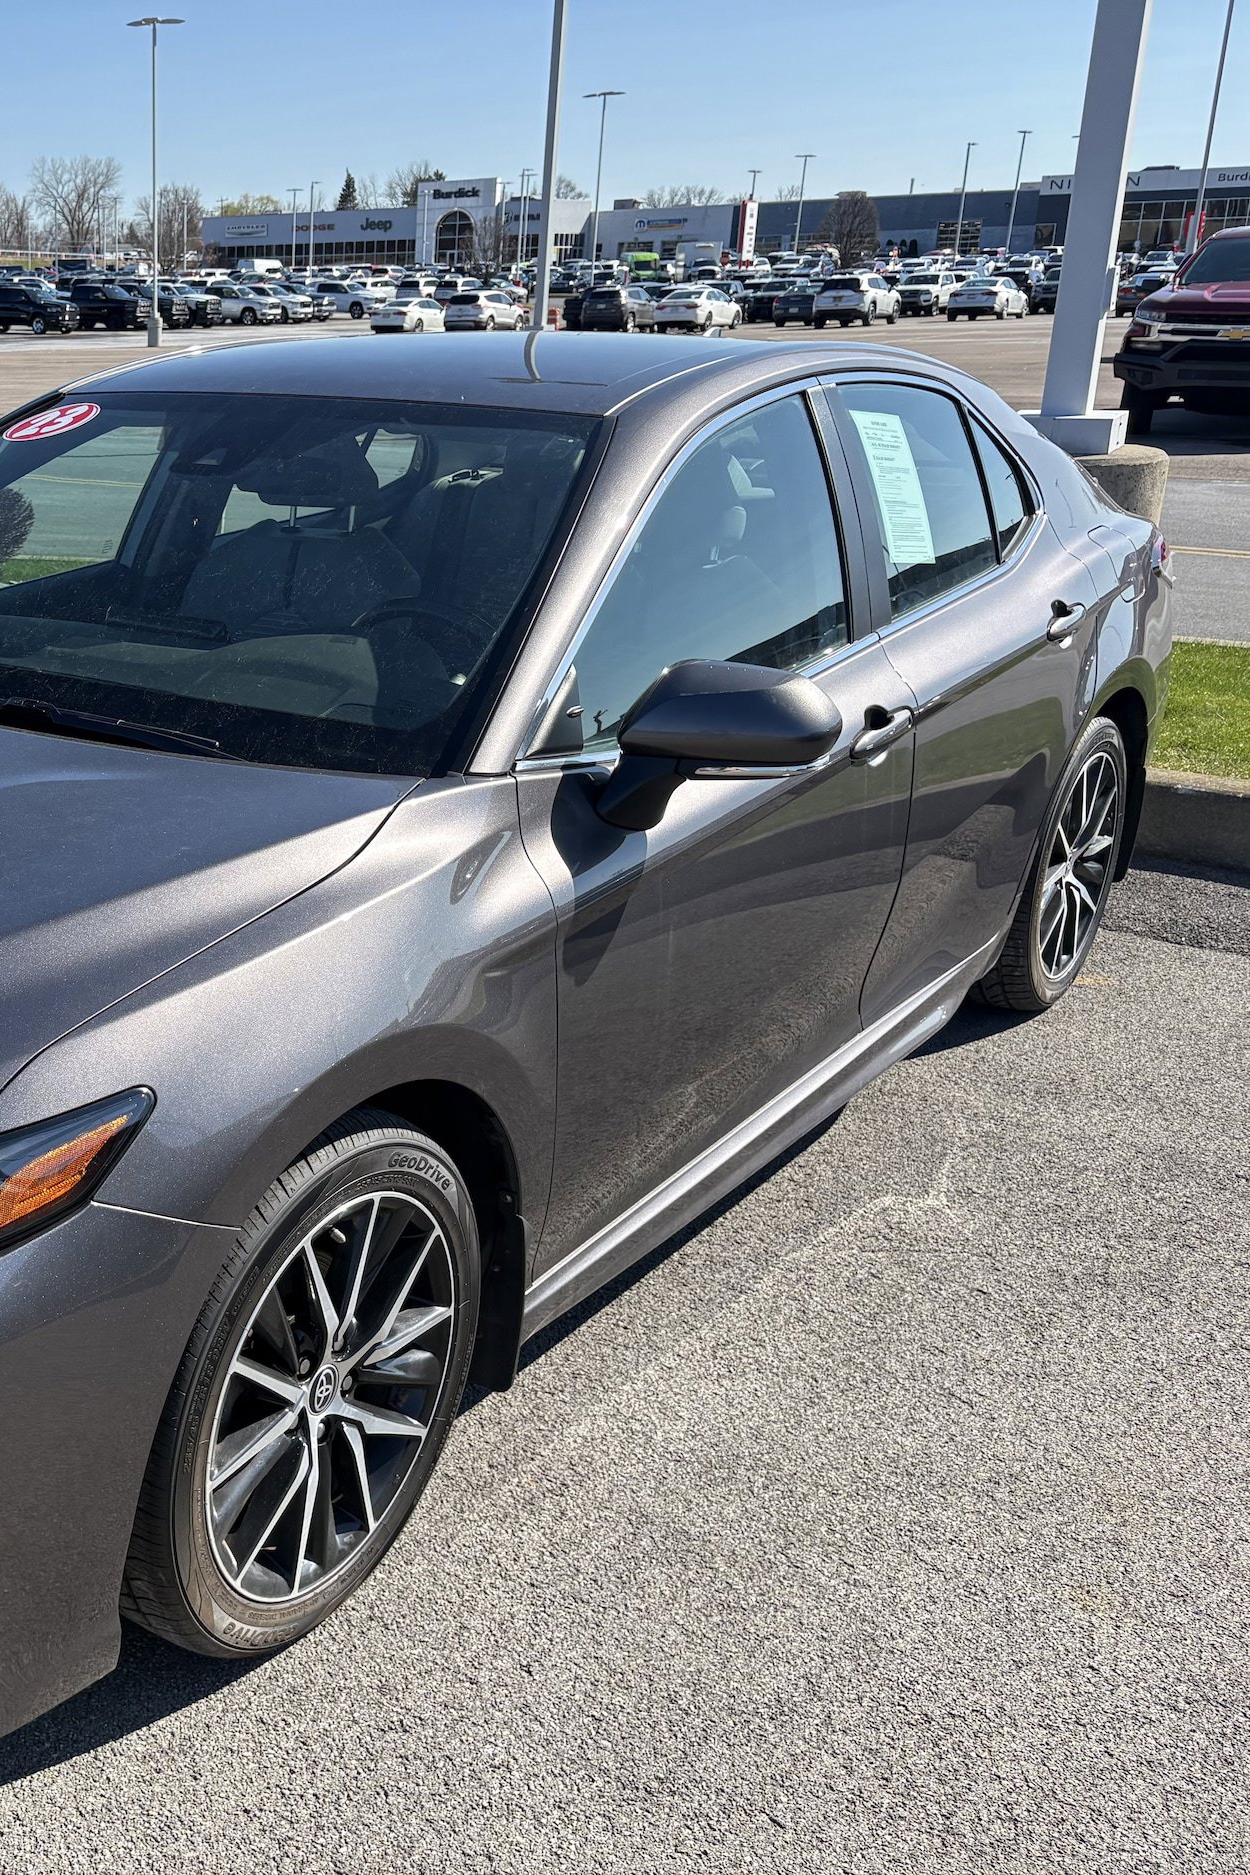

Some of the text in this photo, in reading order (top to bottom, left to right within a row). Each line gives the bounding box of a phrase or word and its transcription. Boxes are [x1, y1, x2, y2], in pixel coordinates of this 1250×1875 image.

[1217, 172, 1250, 182] Burd
[432, 187, 481, 199] Burdick
[360, 217, 393, 232] Jeep
[11, 404, 89, 439] 23
[387, 1150, 451, 1191] GeoDrive
